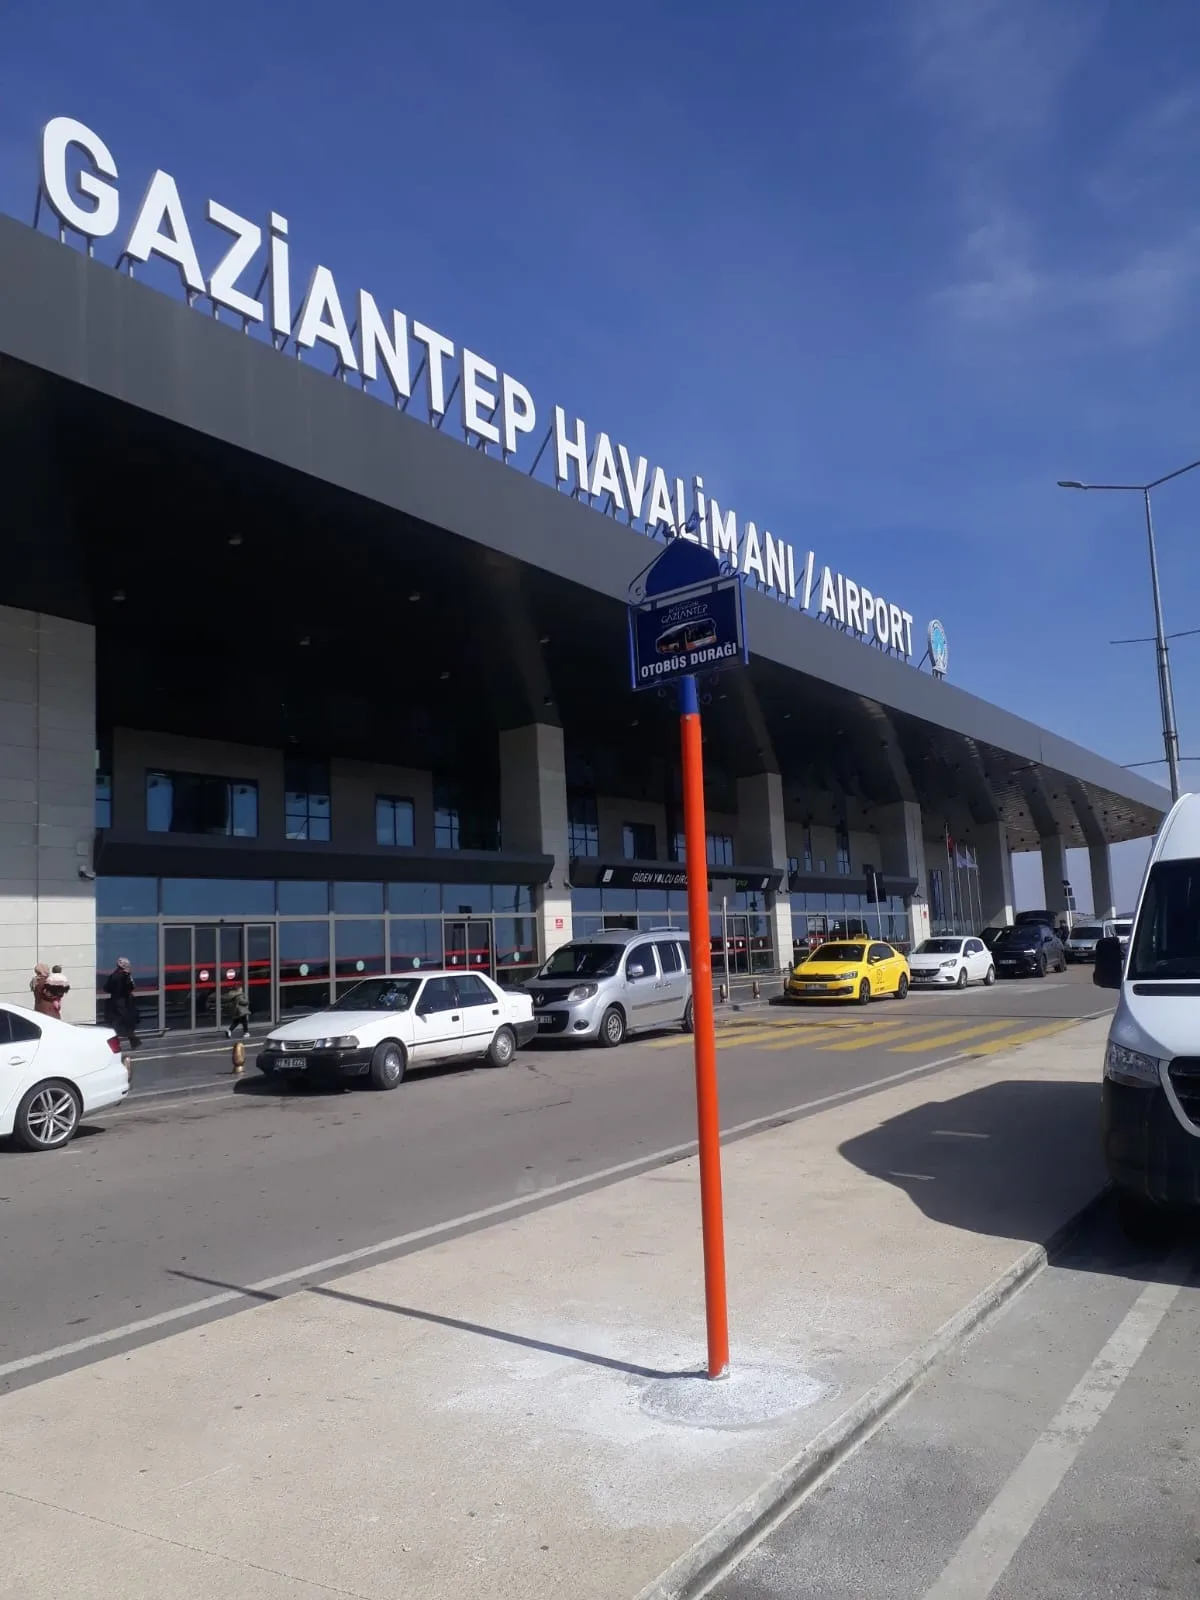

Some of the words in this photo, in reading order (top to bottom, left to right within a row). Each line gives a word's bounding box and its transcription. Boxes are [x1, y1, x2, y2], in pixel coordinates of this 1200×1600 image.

[42, 116, 536, 454] GAZİANTEP
[553, 404, 796, 599] HAVALİMANI
[801, 550, 815, 610] /
[820, 566, 913, 656] AIRPORT
[641, 654, 687, 678] OTOBÜS
[690, 641, 737, 665] DURAĞI
